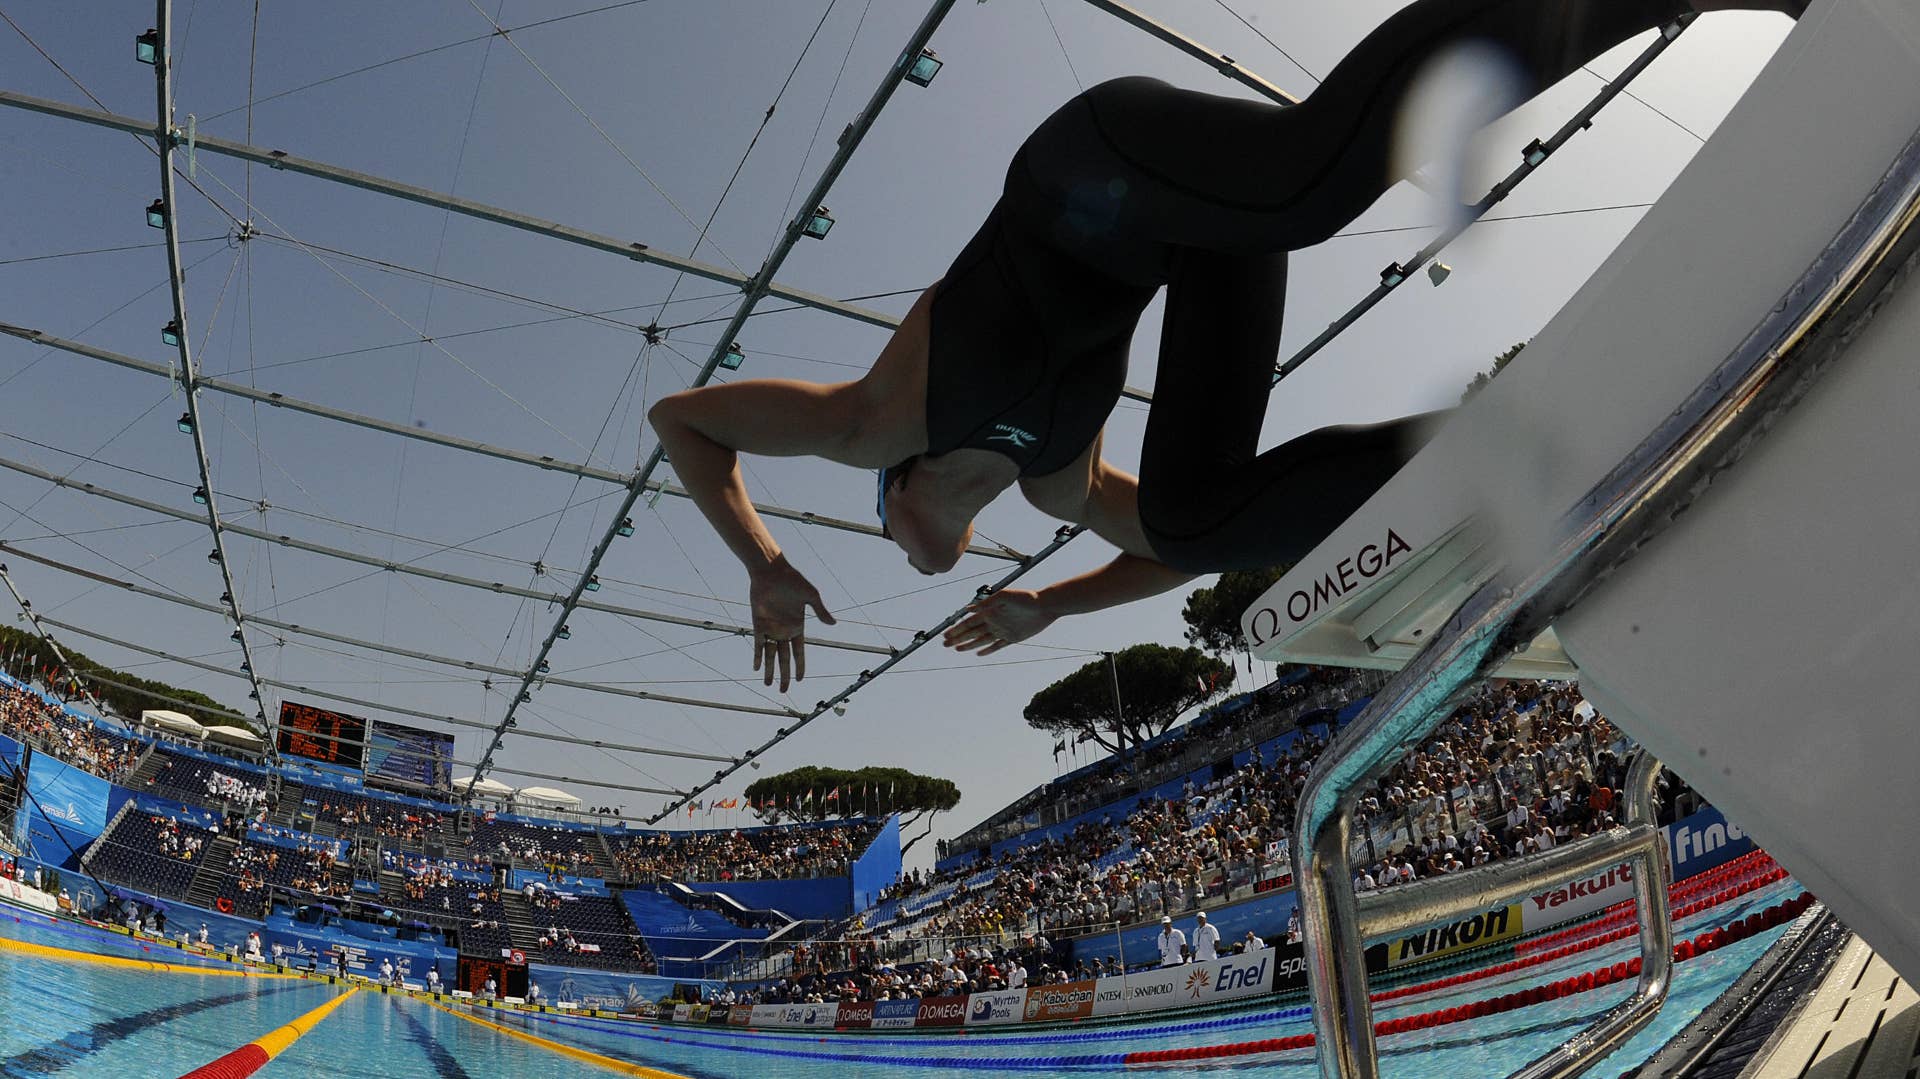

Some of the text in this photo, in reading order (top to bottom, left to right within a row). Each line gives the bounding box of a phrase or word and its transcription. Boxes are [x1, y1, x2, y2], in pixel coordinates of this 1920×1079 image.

[1287, 528, 1412, 622] OMEGA
[1532, 864, 1632, 911] Yakult
[1215, 957, 1267, 992] Enel
[1097, 982, 1173, 1002] INTESA SANPAOLO
[993, 995, 1020, 1008] Myrtha
[845, 1008, 872, 1021] OMEGA
[928, 1004, 965, 1018] OMEGA
[991, 1008, 1011, 1018] Pools
